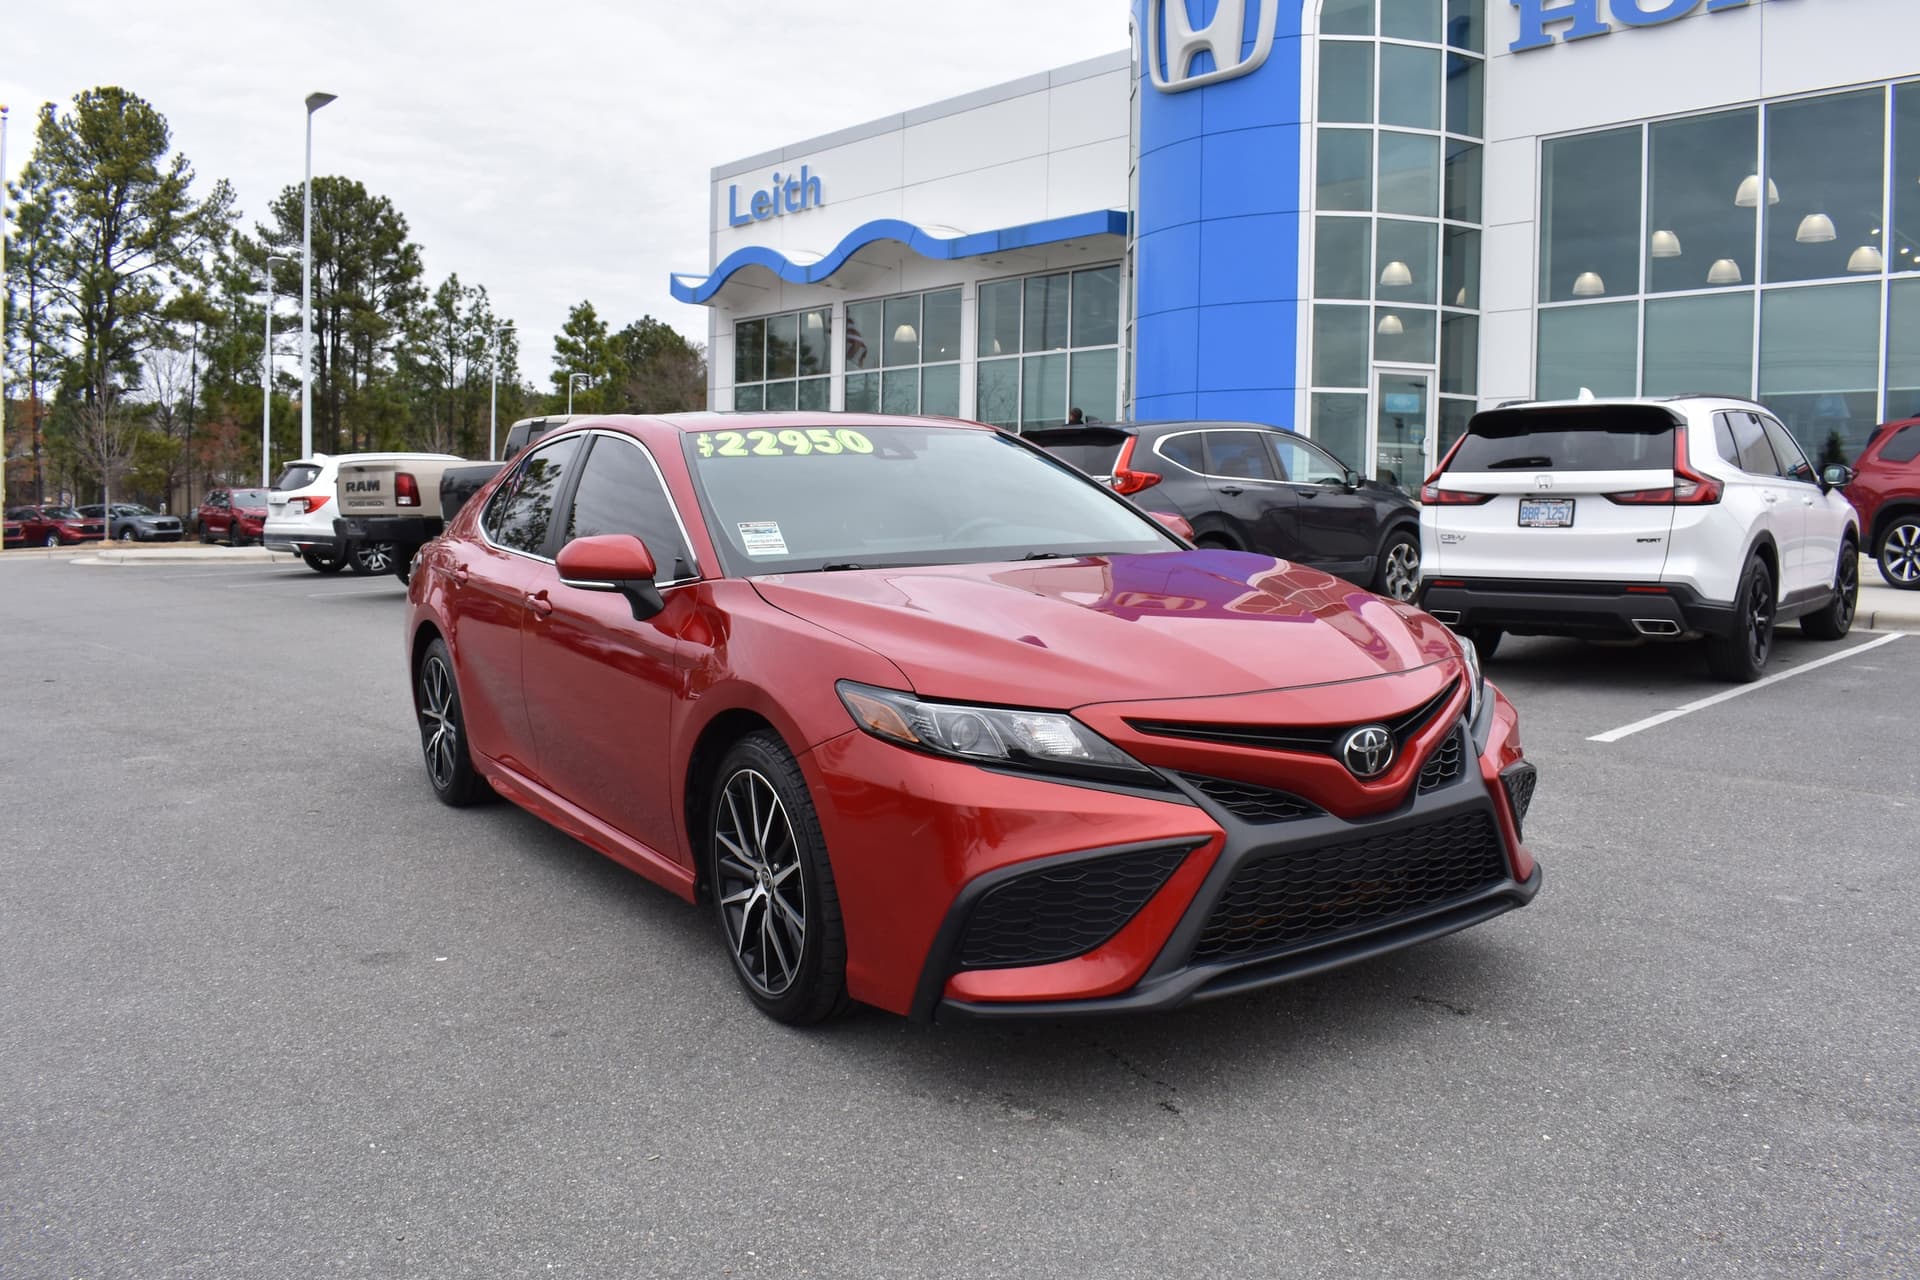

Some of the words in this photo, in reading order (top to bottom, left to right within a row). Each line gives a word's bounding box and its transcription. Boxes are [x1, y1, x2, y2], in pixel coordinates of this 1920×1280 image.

[729, 165, 821, 226] Leith
[696, 429, 875, 457] $22950
[346, 480, 380, 492] RAM
